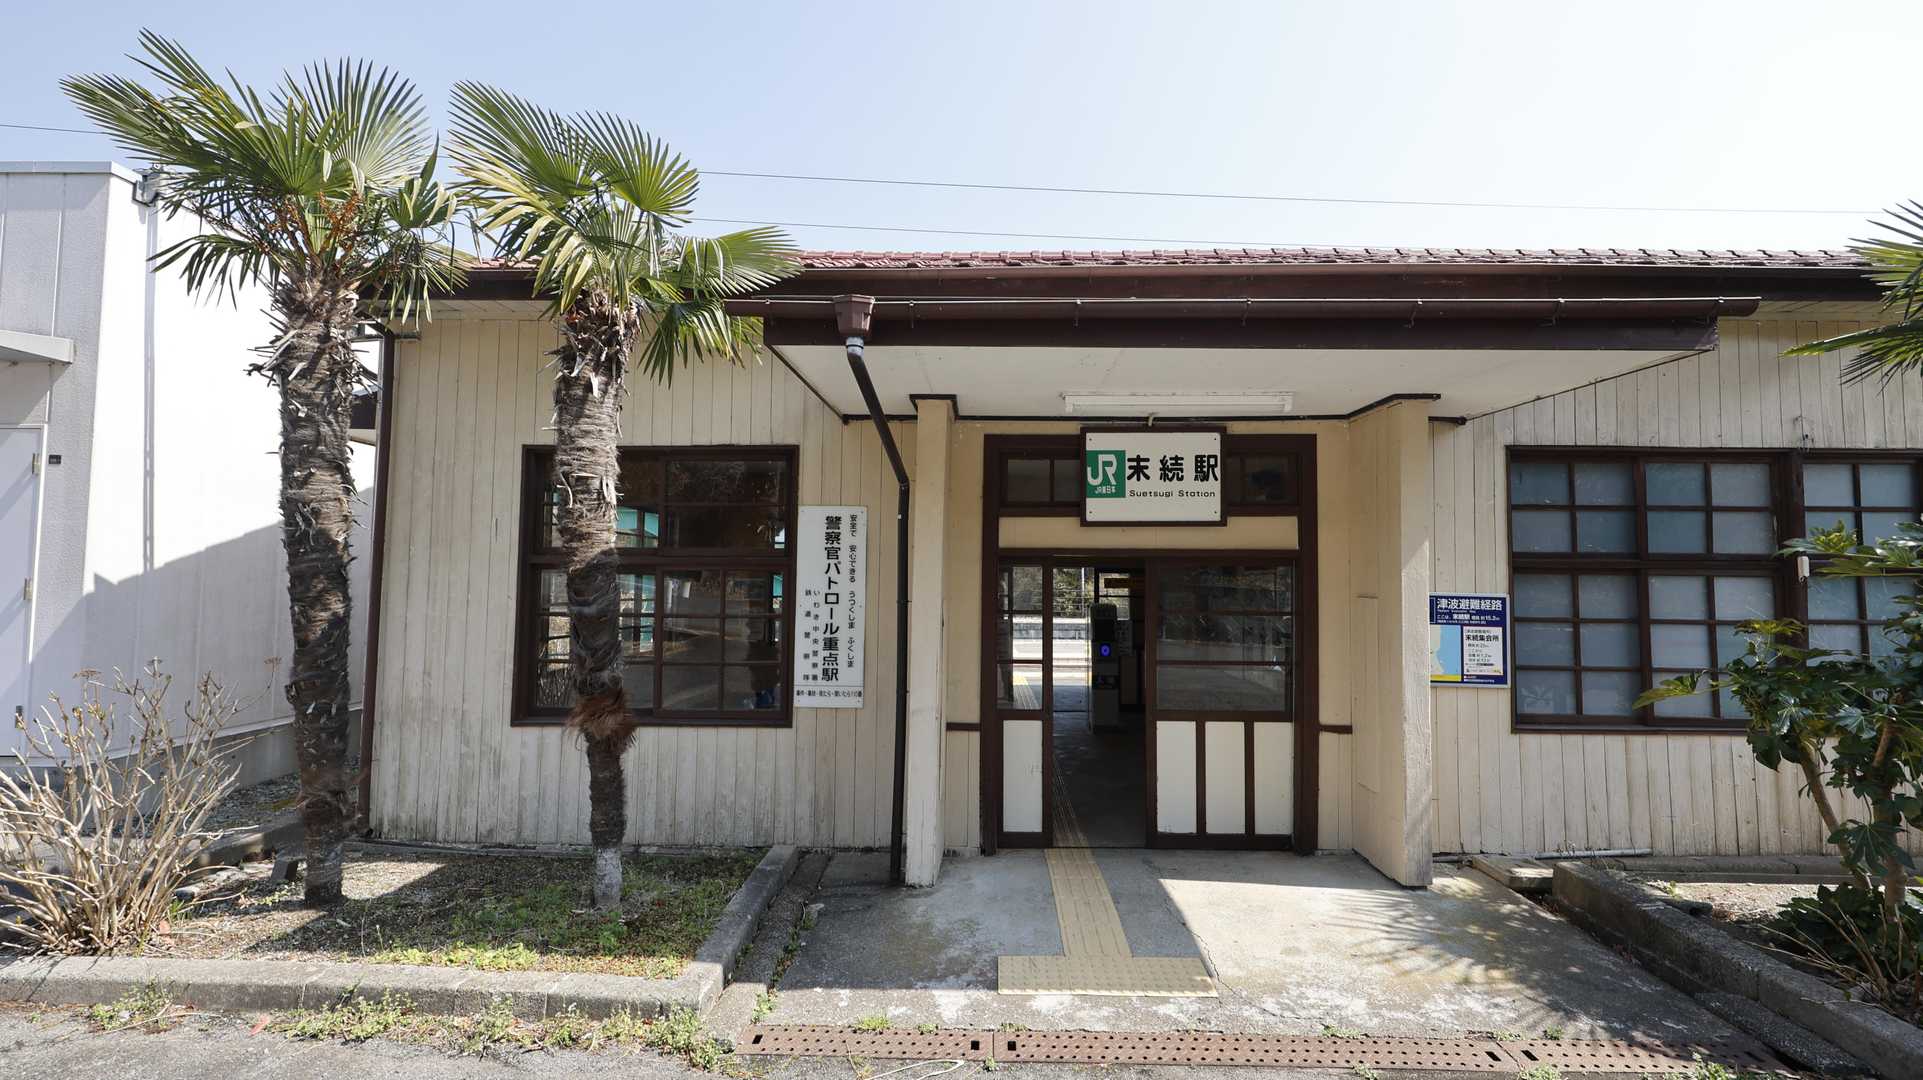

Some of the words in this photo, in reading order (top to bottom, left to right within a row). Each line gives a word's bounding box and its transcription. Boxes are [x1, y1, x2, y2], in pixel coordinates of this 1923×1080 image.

[1087, 454, 1117, 486] JR
[1127, 454, 1218, 482] 末続駅
[1129, 489, 1174, 498] Suetsugi
[1178, 489, 1216, 498] Station
[821, 515, 842, 682] 警察官パトロール重点駅
[1437, 599, 1502, 611] 津波避難経路
